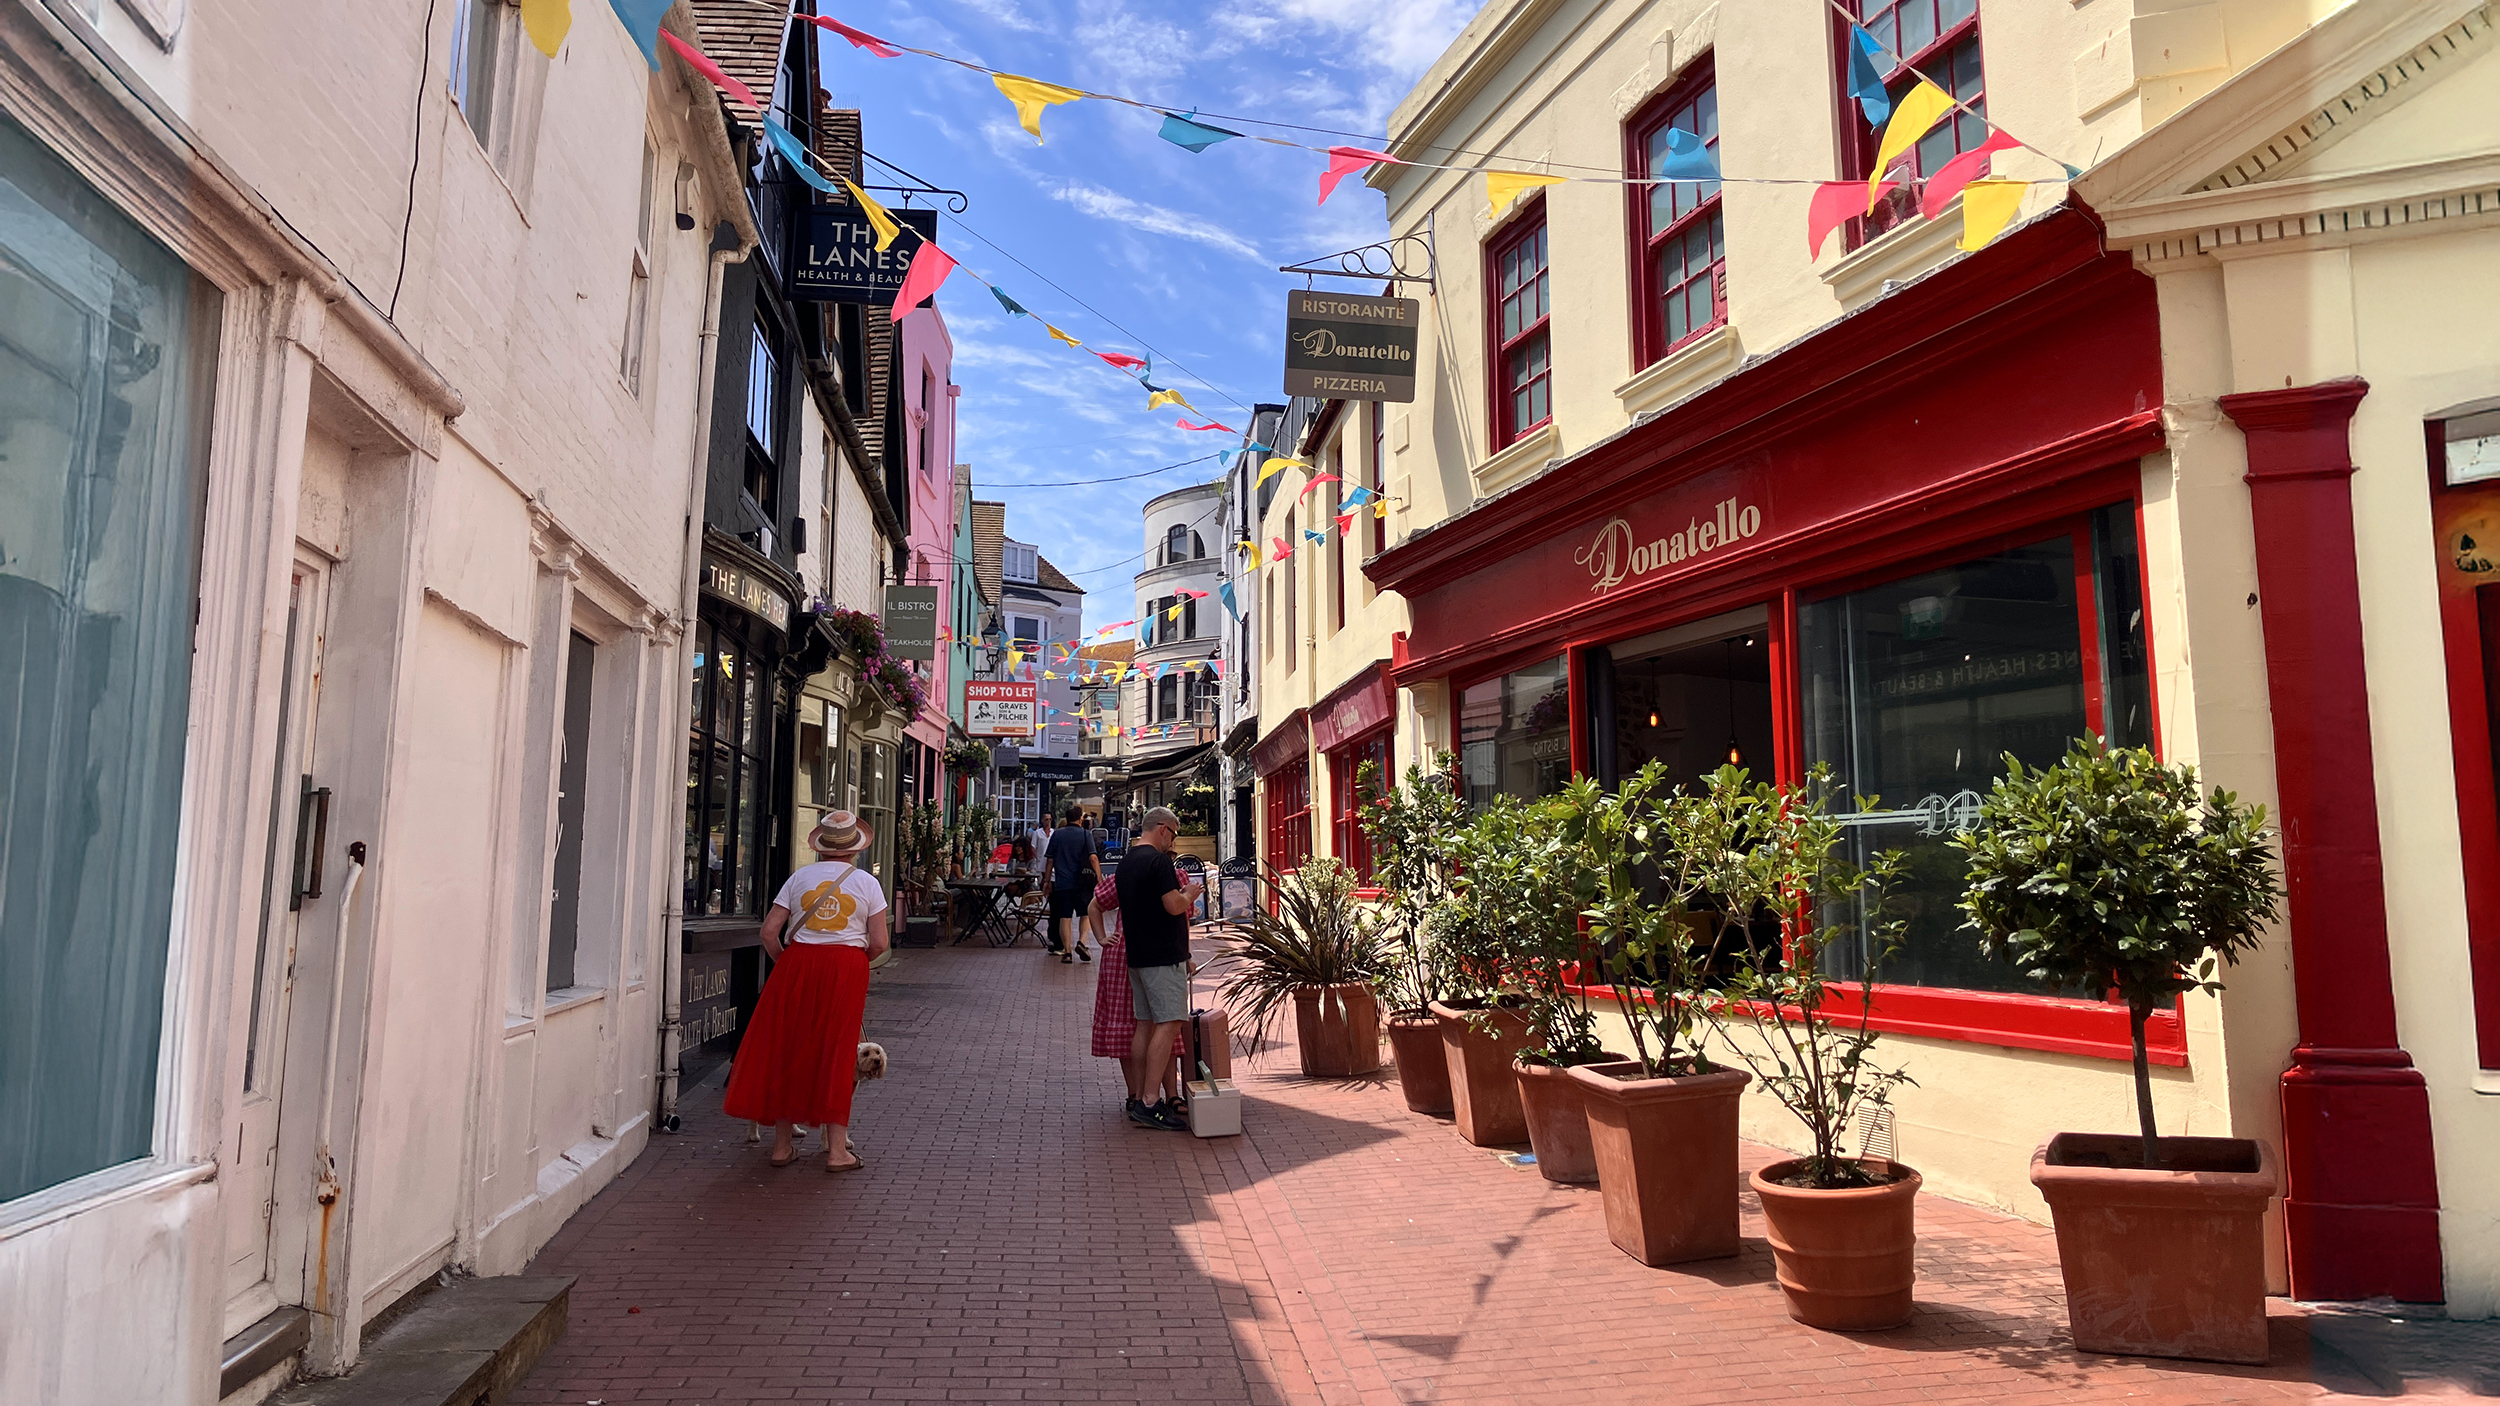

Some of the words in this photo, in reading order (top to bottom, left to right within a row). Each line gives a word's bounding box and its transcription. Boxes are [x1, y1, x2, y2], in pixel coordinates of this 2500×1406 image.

[832, 223, 872, 244] TH
[808, 244, 910, 271] LANES
[797, 269, 850, 282] HEALTH
[855, 272, 863, 282] &
[868, 271, 907, 285] BEAU
[1302, 299, 1405, 320] RISTORANTE
[1292, 327, 1411, 362] Donatello
[1313, 376, 1386, 393] PIZZERIA
[1574, 496, 1761, 595] Donatello
[709, 564, 736, 596] THE
[740, 577, 772, 614] LANES
[886, 601, 896, 611] IL
[897, 601, 935, 612] BISTRO
[968, 686, 997, 696] SHOP
[999, 686, 1013, 697] TO
[1015, 687, 1034, 698] LET
[998, 702, 1028, 710] GRAVES
[998, 713, 1028, 721] PILCHER
[1041, 772, 1074, 780] RESTAURANT
[1223, 862, 1249, 874] Coco's
[687, 968, 704, 1003] THE
[705, 966, 727, 998] LANES
[703, 1008, 711, 1043] &
[711, 1007, 737, 1039] BEAUTY
